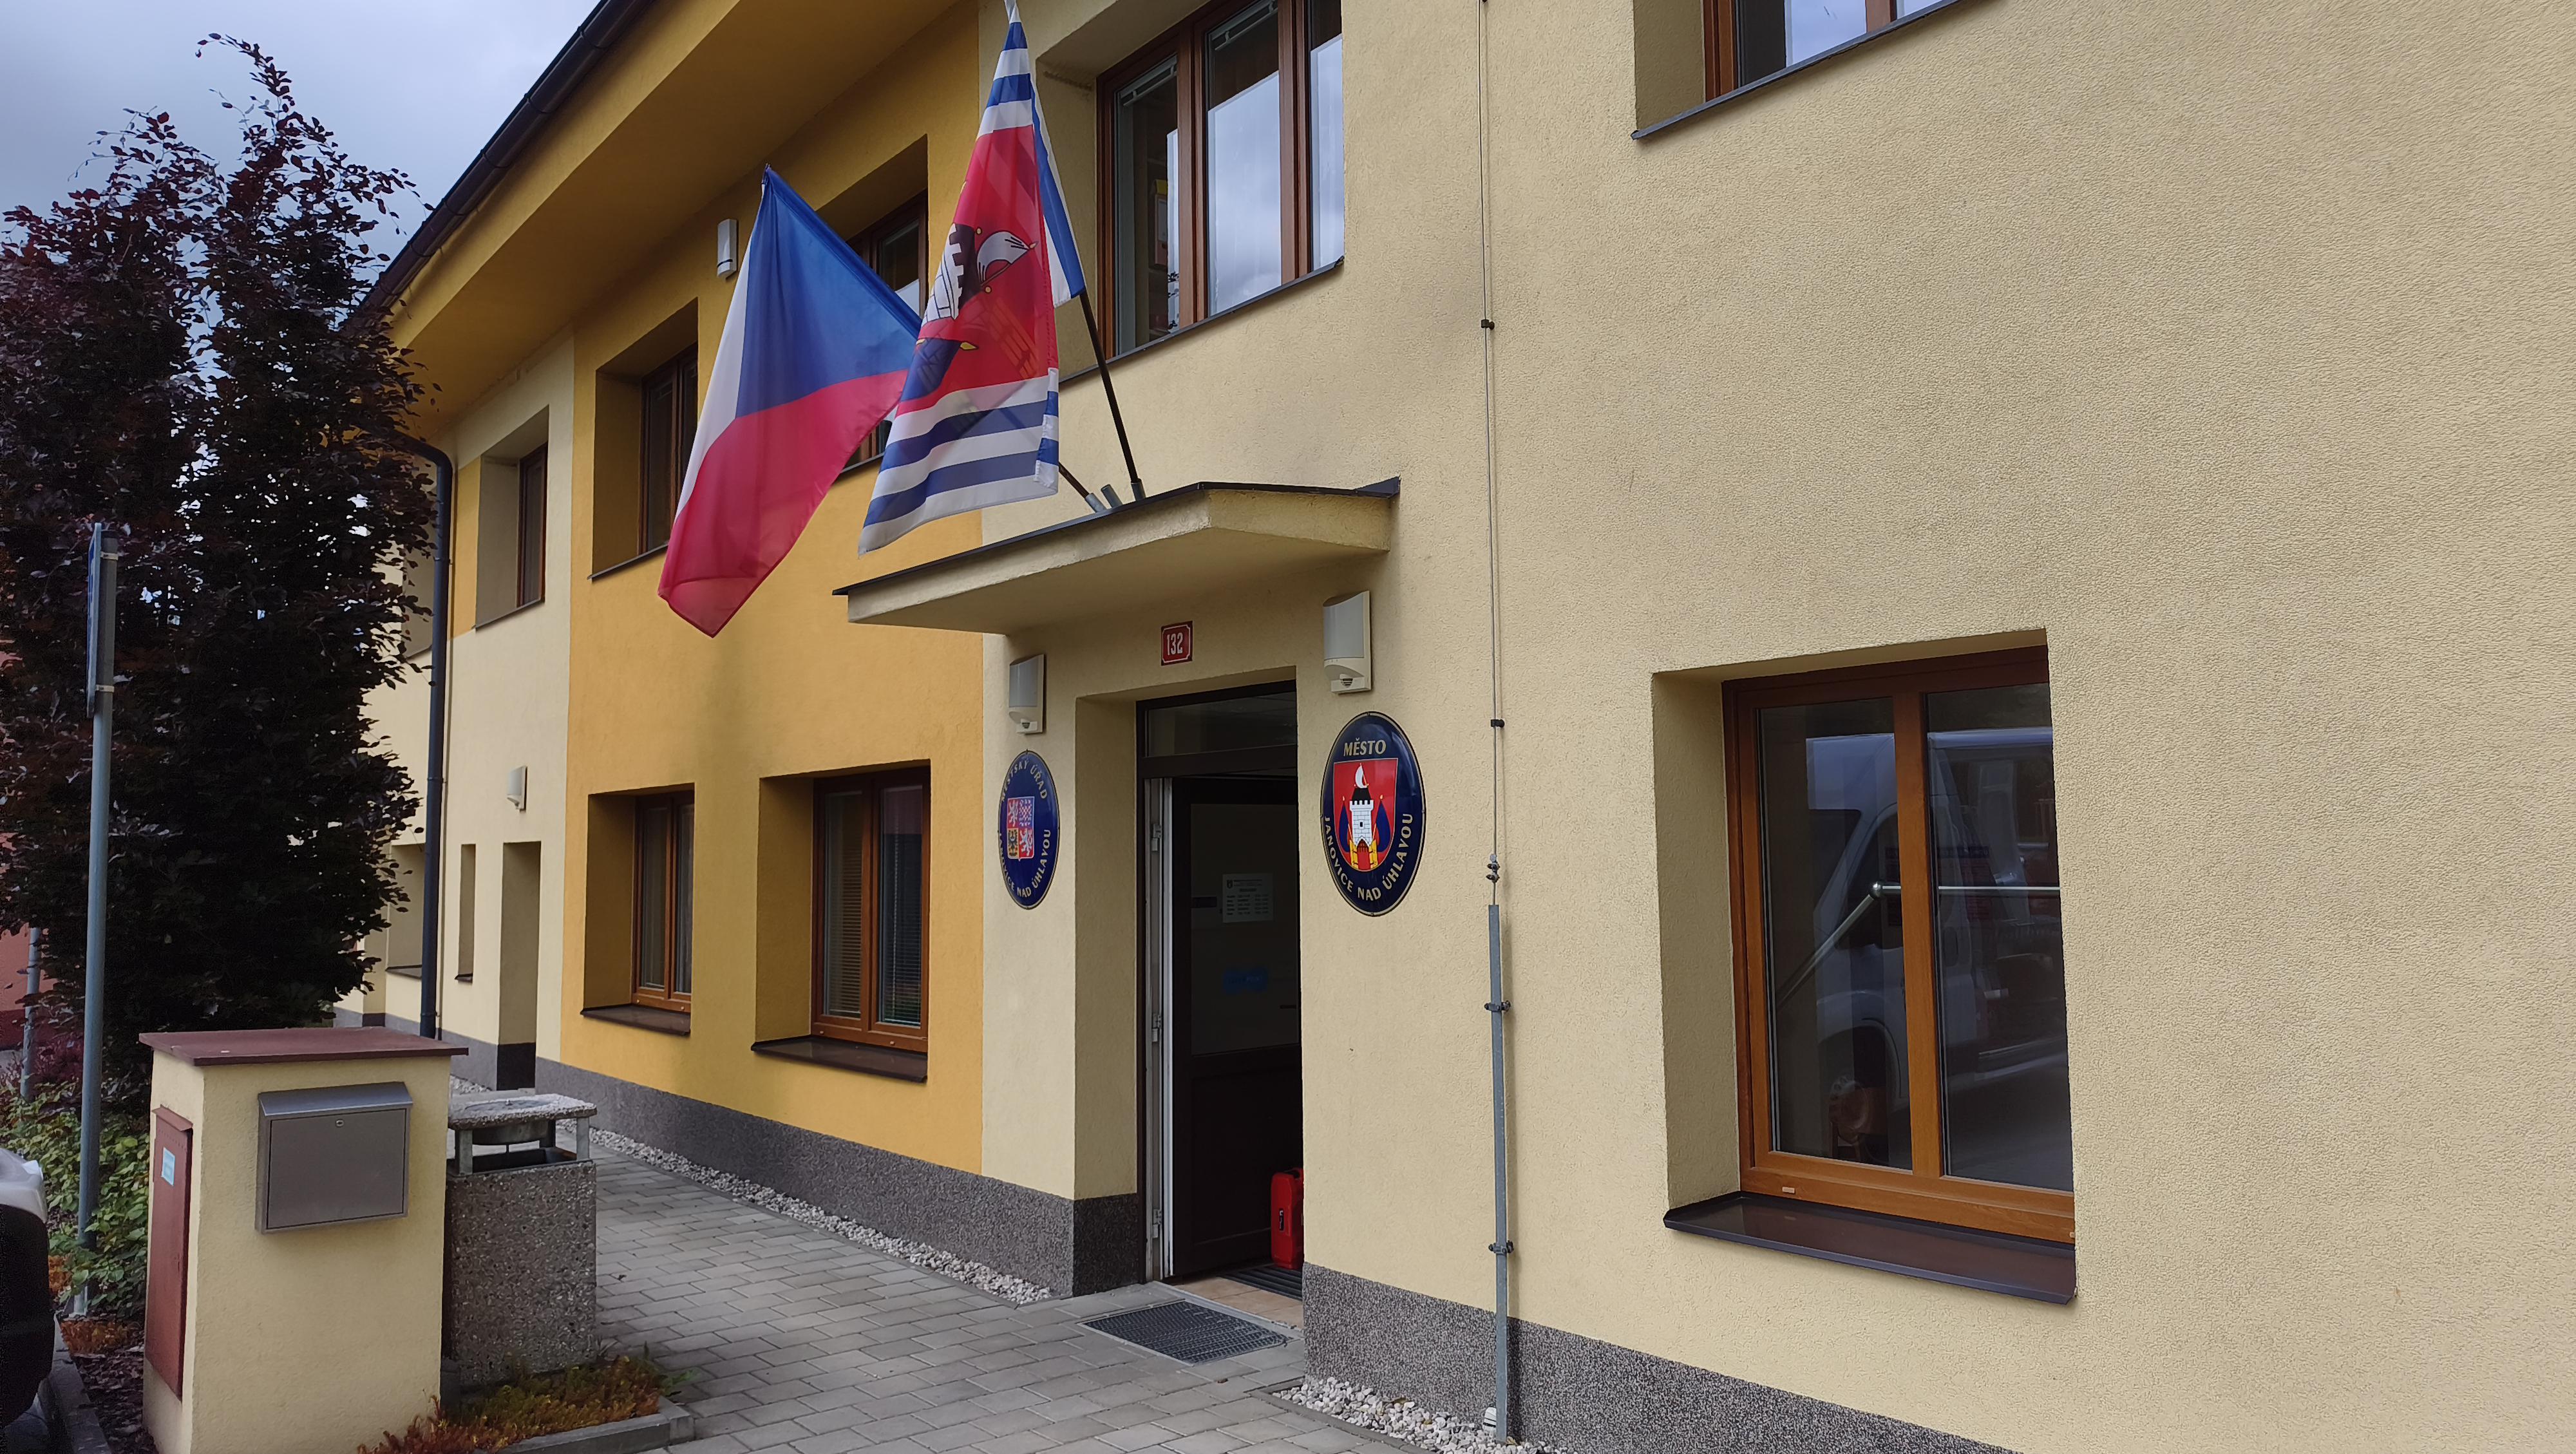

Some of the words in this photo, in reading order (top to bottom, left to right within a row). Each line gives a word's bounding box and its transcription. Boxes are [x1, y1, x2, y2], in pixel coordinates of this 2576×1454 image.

[1167, 632, 1183, 656] 132
[1343, 737, 1387, 757] MĚSTO
[1030, 764, 1048, 799] ÚŘAD
[1017, 886, 1032, 898] NAD
[1031, 829, 1051, 889] ÚHLAVOU
[1325, 816, 1354, 892] JANOVICE
[1358, 887, 1381, 901] NAD
[1382, 813, 1413, 890] ÚHLAVOU
